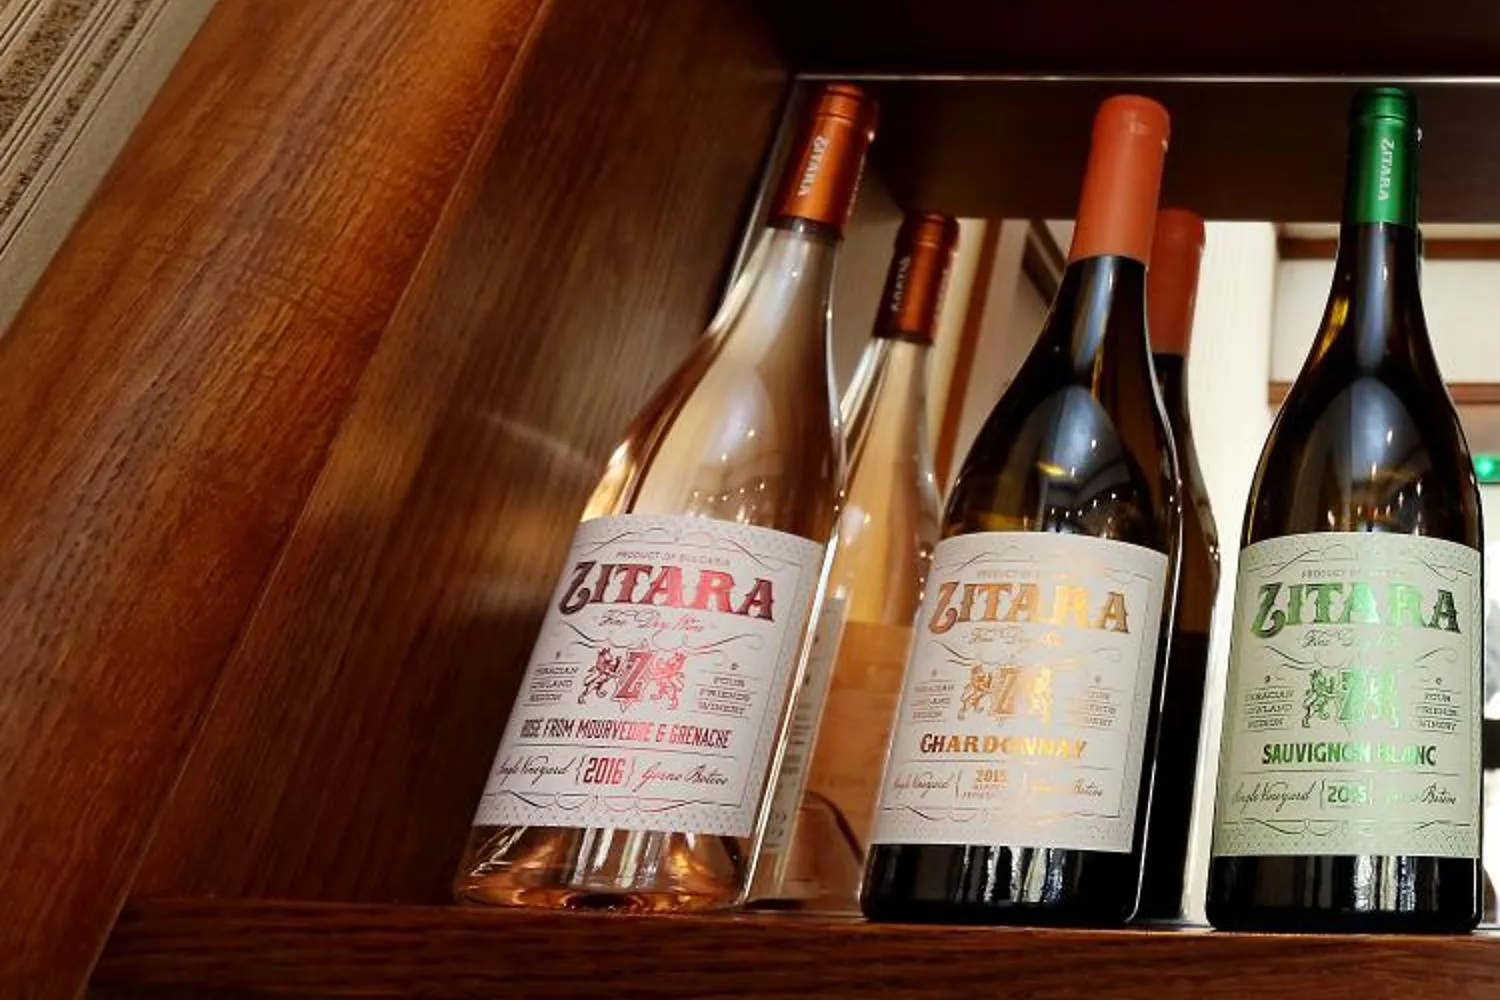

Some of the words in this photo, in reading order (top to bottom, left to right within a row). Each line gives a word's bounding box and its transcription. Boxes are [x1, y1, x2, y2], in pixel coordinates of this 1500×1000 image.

[1378, 138, 1395, 201] ZITARA
[558, 559, 775, 623] ZITARA
[927, 581, 1131, 635] ZITARA
[1250, 580, 1463, 640] ZITARA
[542, 718, 577, 739] FROM
[669, 724, 735, 749] GRENACHE
[919, 732, 1089, 760] CHARDONNAY
[1261, 741, 1372, 766] SAUVIGNON
[1377, 743, 1438, 767] BLANC
[583, 756, 627, 786] 2016
